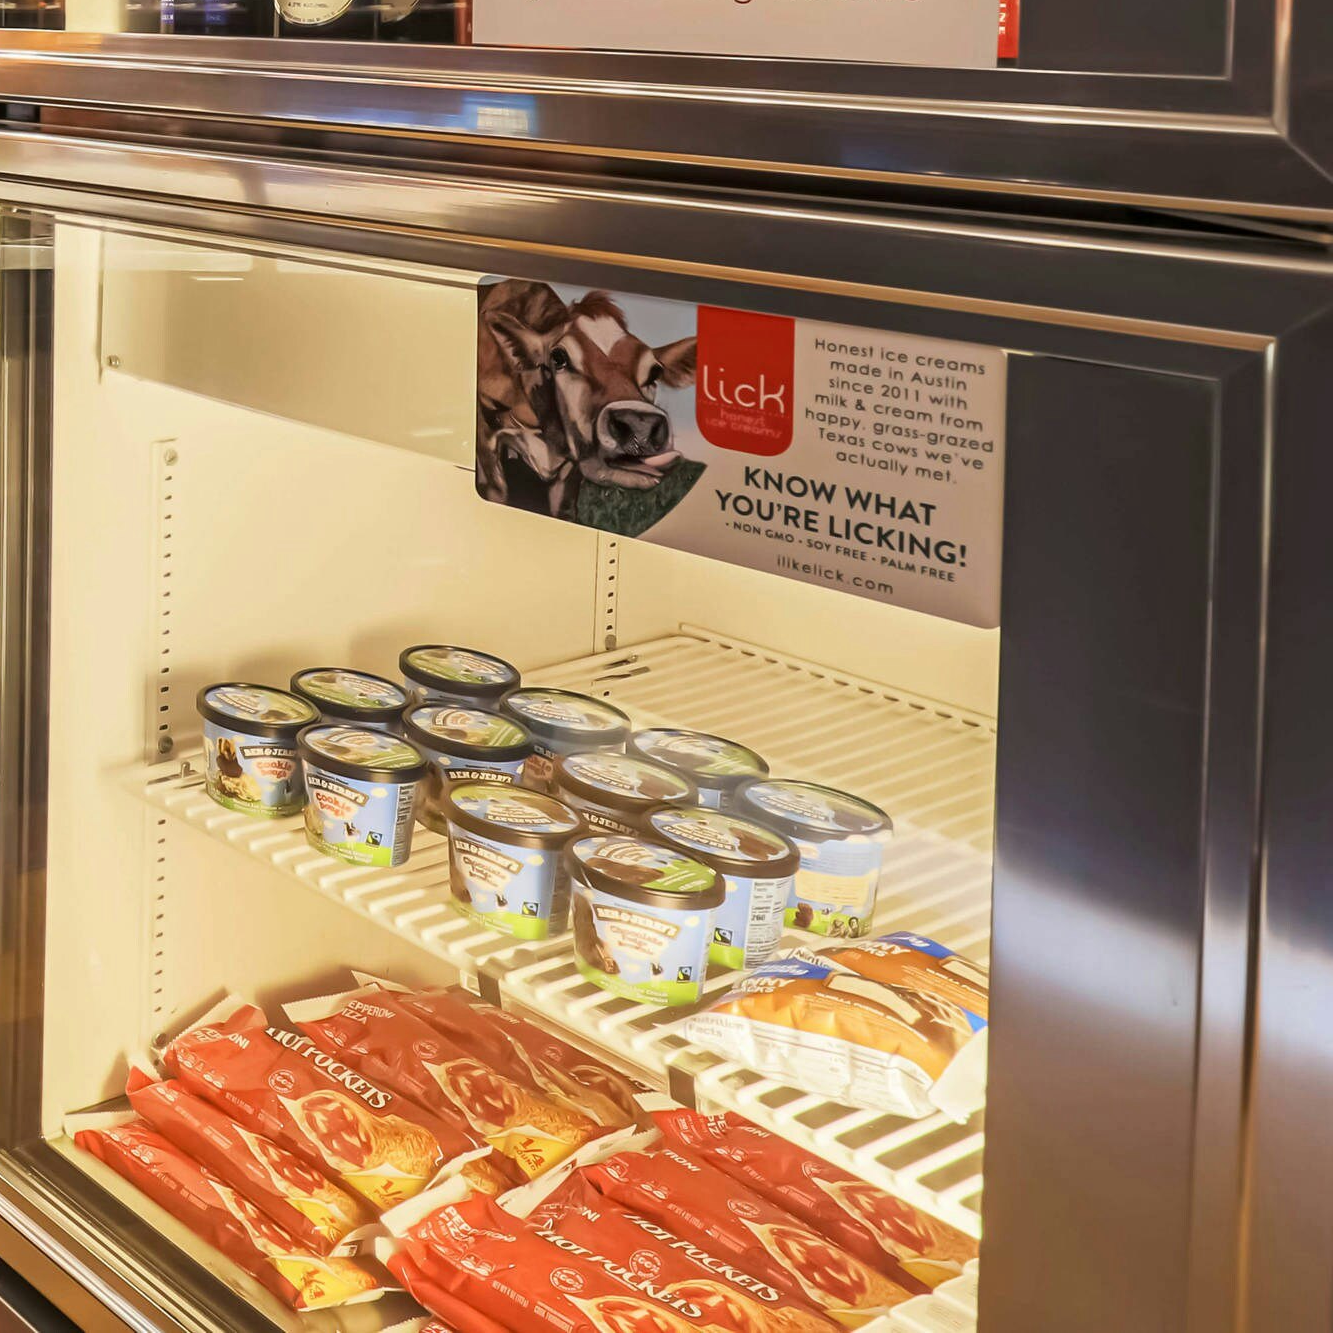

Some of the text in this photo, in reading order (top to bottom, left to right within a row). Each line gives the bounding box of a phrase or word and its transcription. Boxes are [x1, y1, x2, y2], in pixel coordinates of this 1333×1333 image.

[814, 338, 986, 376] Honest ice creams
[830, 359, 968, 392] made in Austin
[814, 392, 984, 433] milk & cream from
[828, 378, 969, 412] since 2011 with
[719, 409, 767, 426] honest
[873, 422, 995, 454] grass-grazed
[818, 427, 985, 471] Texas cows we've
[836, 449, 958, 485] actually met.
[743, 465, 937, 527] KNOW WHAT
[715, 489, 968, 568] YOU'RE LICKING!
[733, 521, 957, 584] NON GMO SOY FREE PALM FREE
[775, 554, 894, 596] ilikelick.com
[302, 1045, 394, 1111] POCKETS
[536, 1229, 702, 1318] HOT POCKETS
[621, 1212, 782, 1303] HOT POCKETS
